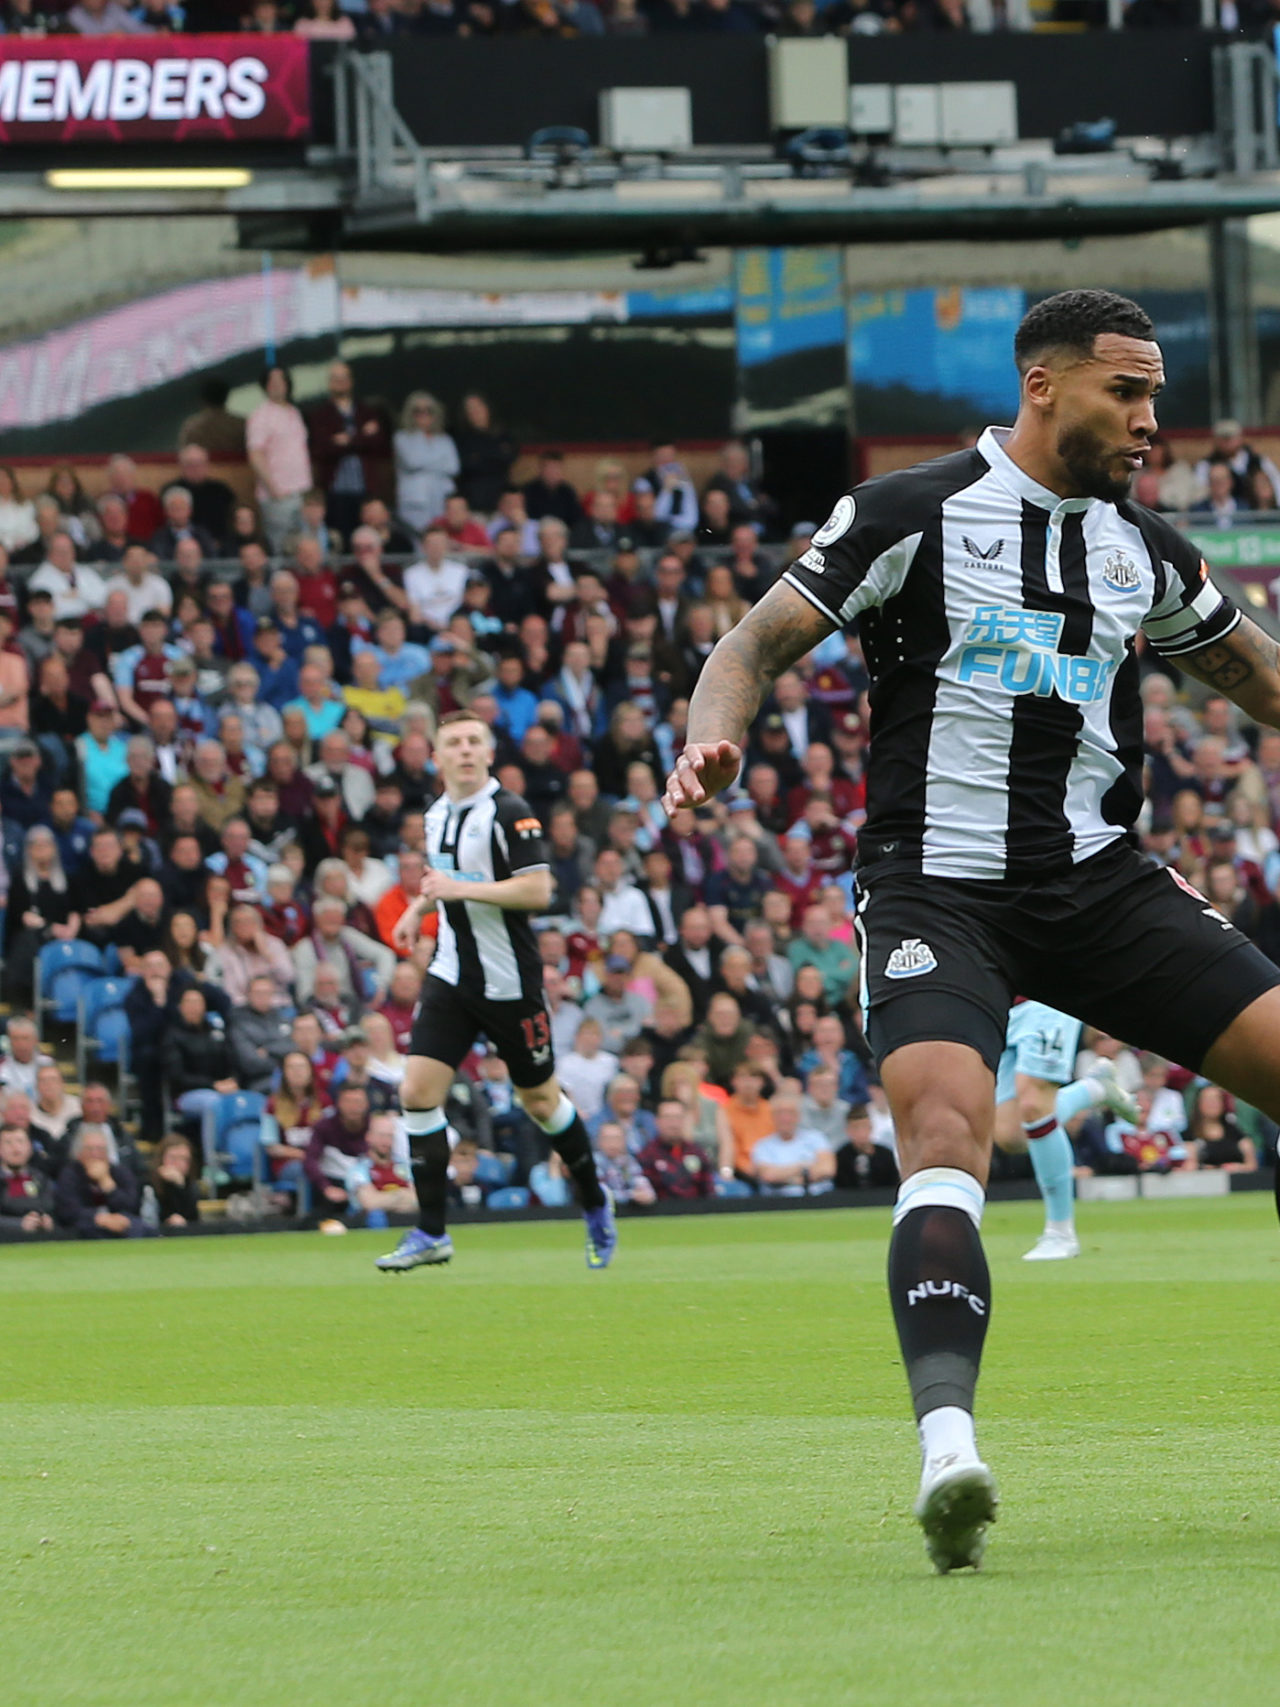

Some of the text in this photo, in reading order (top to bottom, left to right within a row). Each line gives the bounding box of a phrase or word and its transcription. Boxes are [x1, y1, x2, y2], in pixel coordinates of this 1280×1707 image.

[966, 605, 1062, 649] 乐天堂
[520, 1011, 550, 1048] 13
[907, 1280, 985, 1315] NUFC
